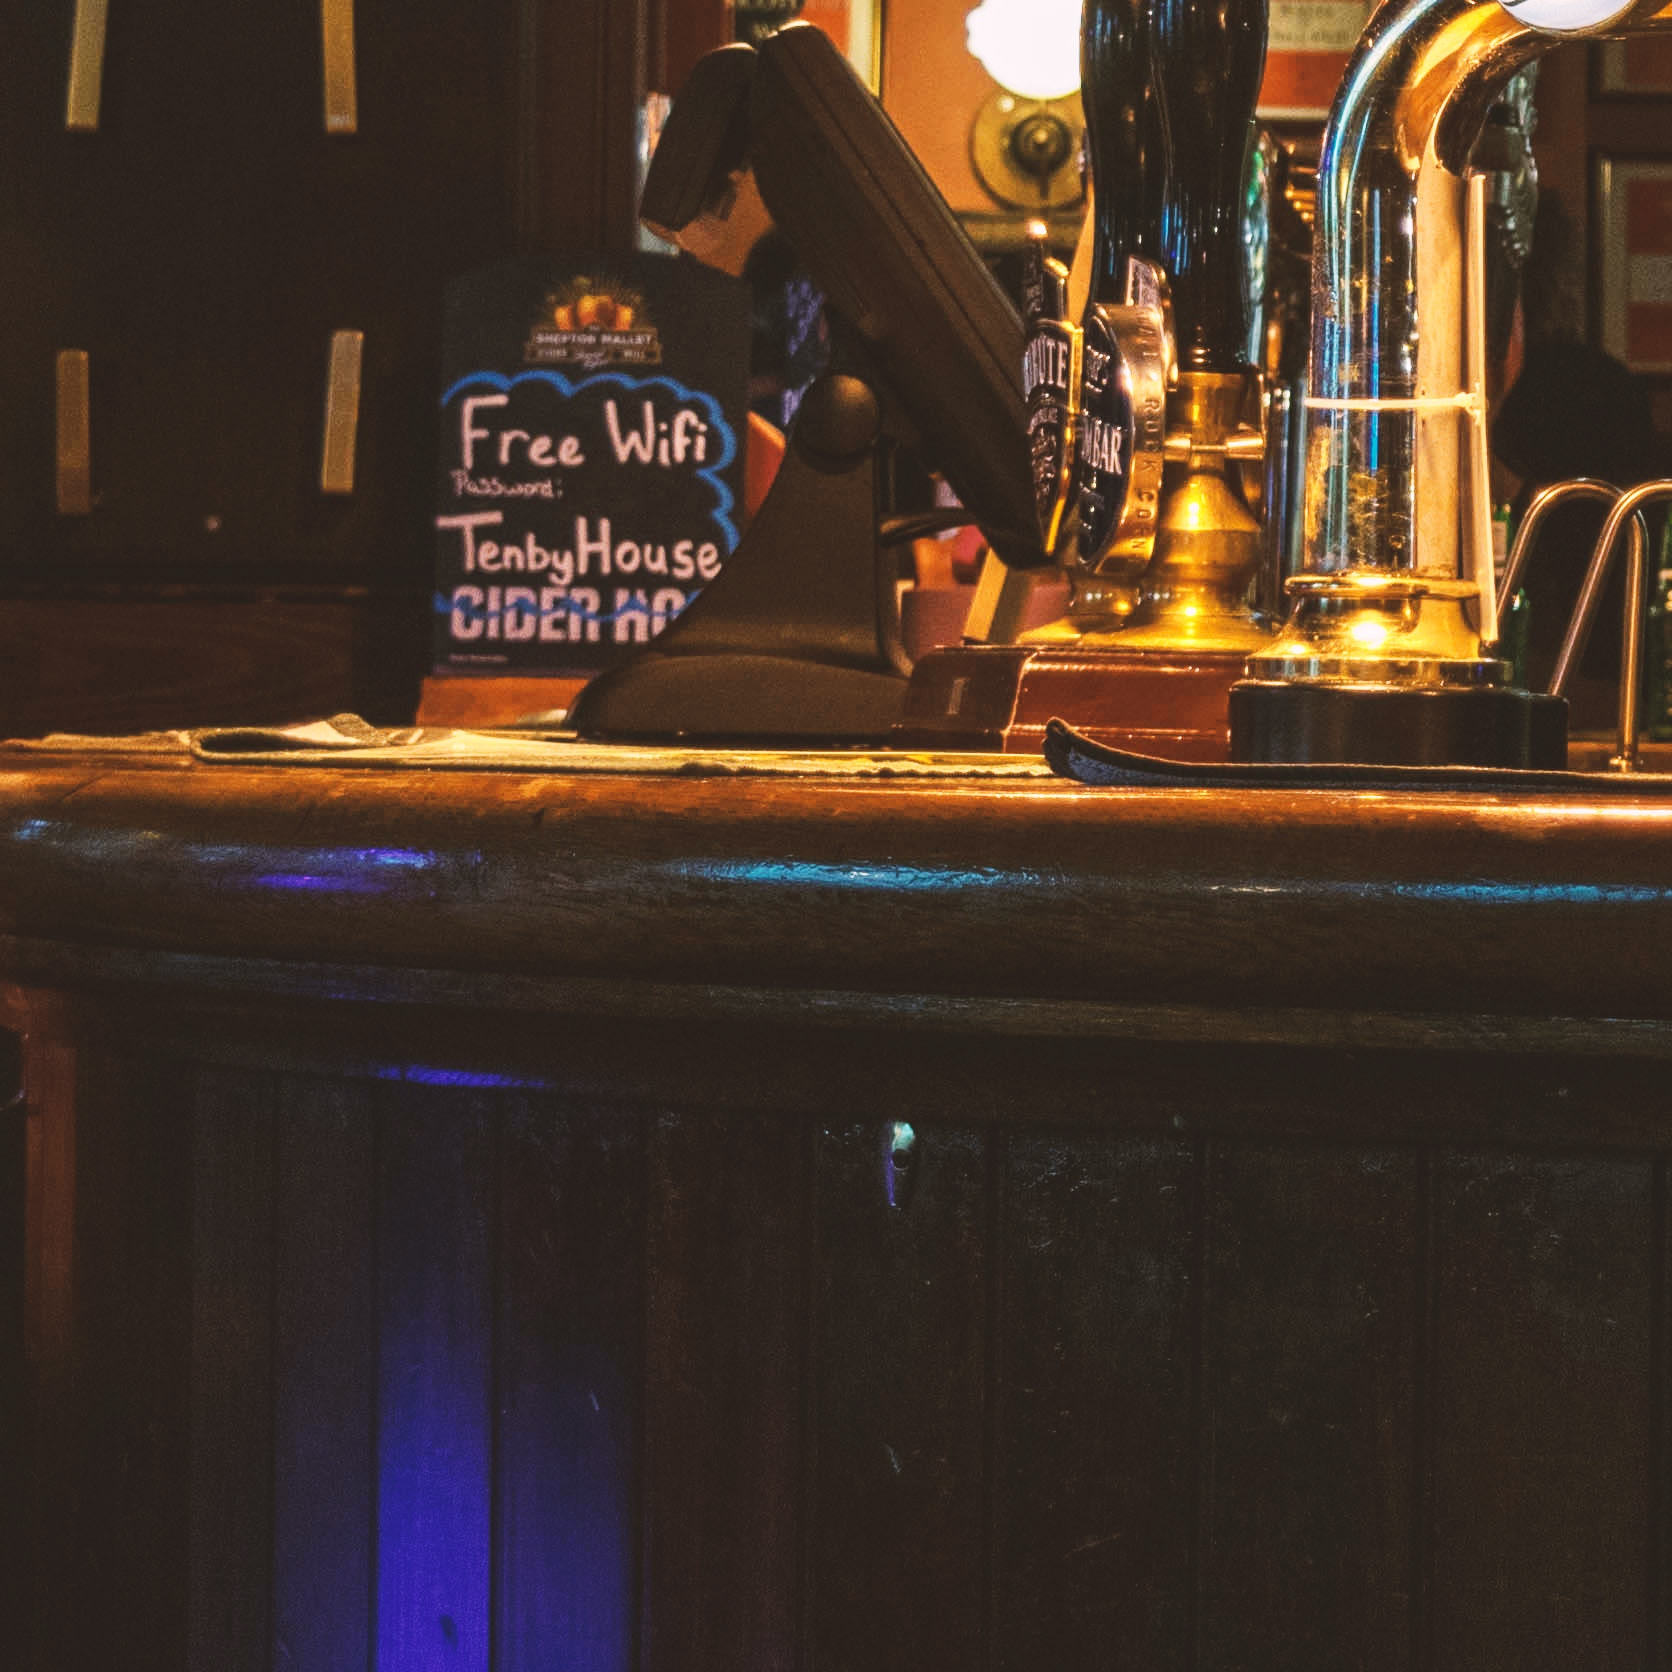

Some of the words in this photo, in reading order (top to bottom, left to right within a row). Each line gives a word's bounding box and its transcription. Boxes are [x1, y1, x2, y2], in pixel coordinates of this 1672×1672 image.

[460, 394, 586, 469] Free
[604, 399, 708, 467] Wifi
[450, 585, 601, 643] CIDER
